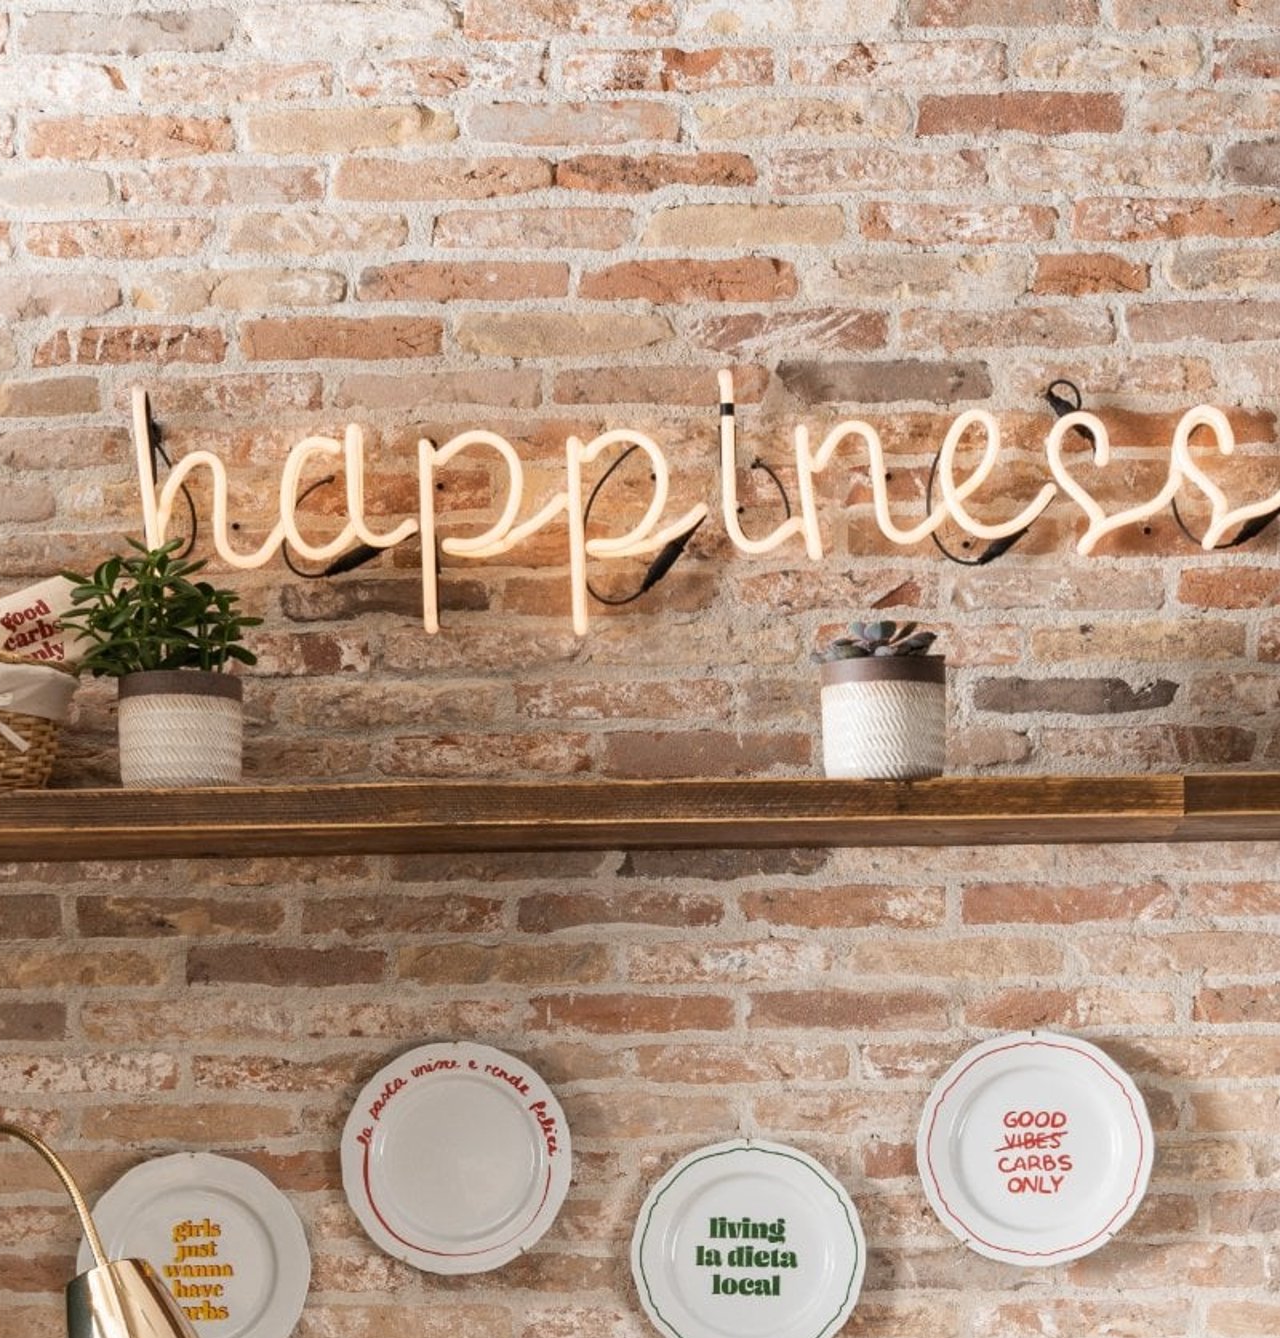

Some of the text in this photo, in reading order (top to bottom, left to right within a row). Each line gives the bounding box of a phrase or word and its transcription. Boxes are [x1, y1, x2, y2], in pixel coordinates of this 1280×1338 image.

[0, 598, 51, 633] good
[23, 640, 65, 661] nly
[369, 1077, 408, 1120] pasta
[468, 1059, 478, 1070] e
[484, 1063, 532, 1097] rende
[1002, 1110, 1067, 1129] GOOD
[997, 1154, 1073, 1173] CARBS
[1007, 1175, 1066, 1194] ONLY
[172, 1218, 222, 1242] girls
[709, 1216, 786, 1244] living
[175, 1240, 218, 1262] just
[695, 1245, 798, 1269] la dieta
[163, 1262, 234, 1278] wanna
[173, 1279, 224, 1299] have
[711, 1274, 781, 1296] local
[181, 1301, 230, 1322] arbs
